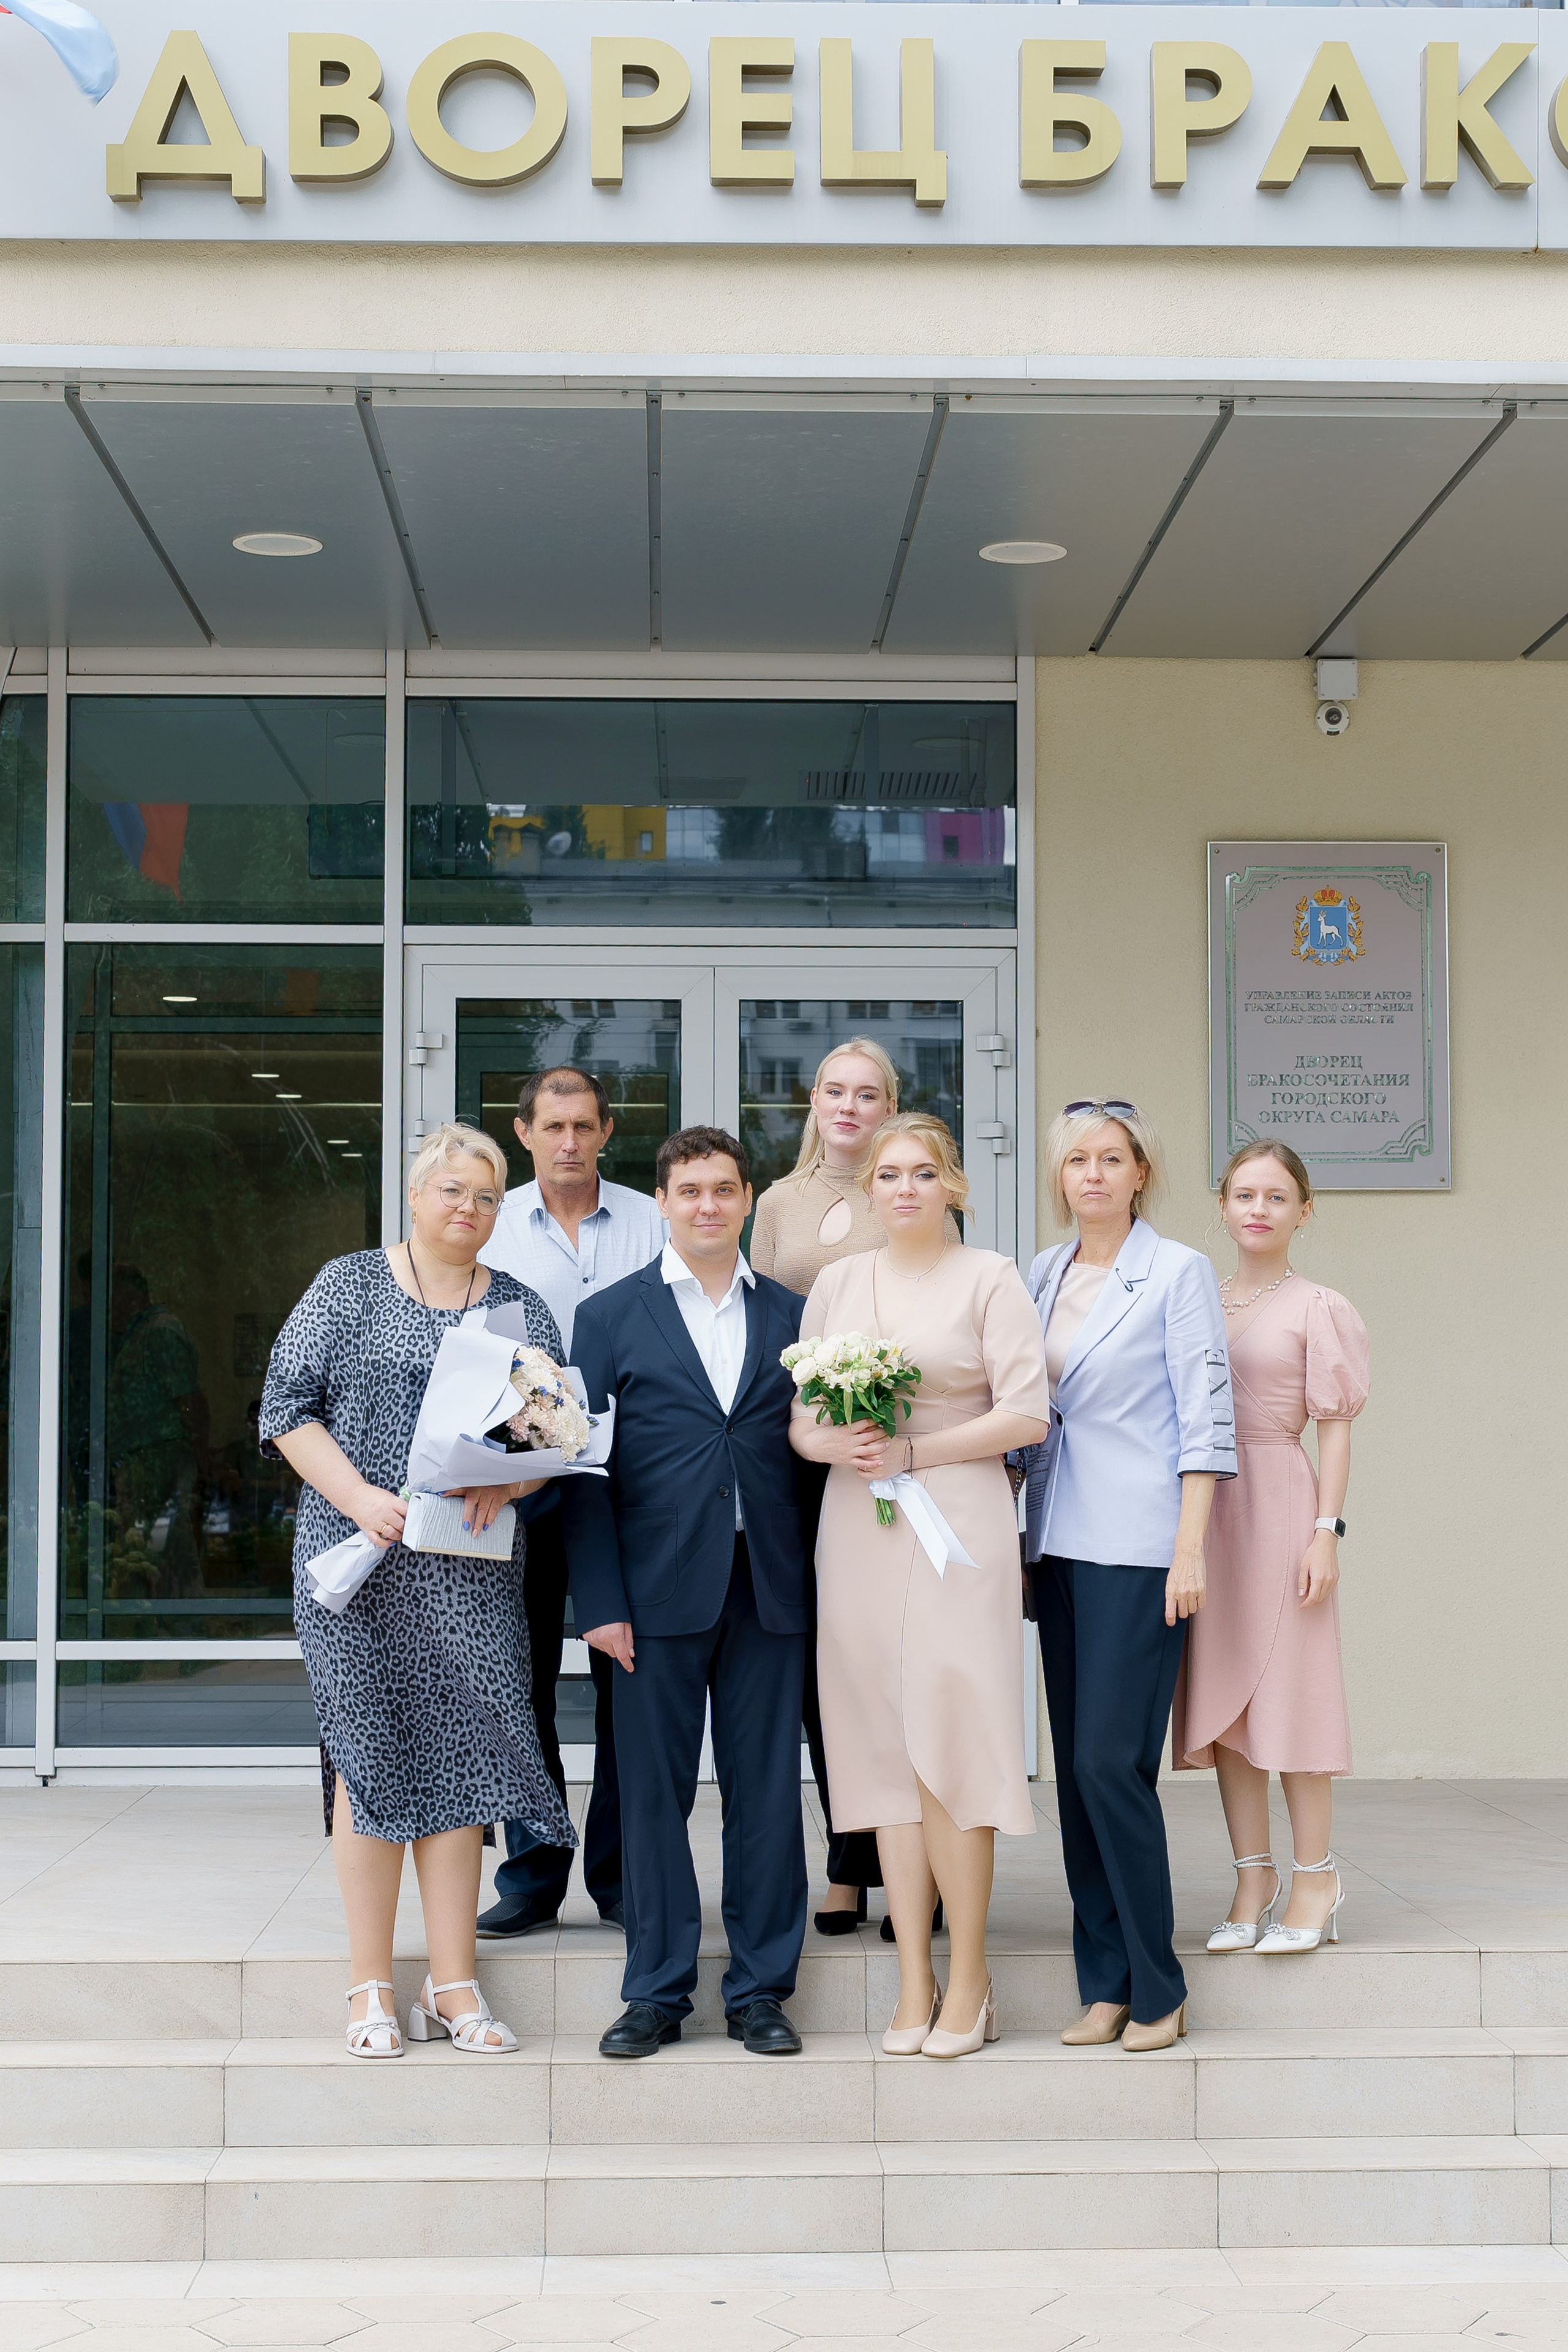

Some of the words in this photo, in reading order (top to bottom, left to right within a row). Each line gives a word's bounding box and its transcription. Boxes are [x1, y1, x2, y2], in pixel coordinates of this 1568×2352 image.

[106, 29, 947, 208] ДВОРЕЦ
[1019, 39, 1568, 190] БРАК
[1245, 990, 1322, 1000] УПРАВЛЕНИЕ
[1324, 990, 1371, 1000] ЗАПИСИ
[1374, 990, 1412, 1000] АКТОВ
[1244, 1003, 1338, 1012] ГРАЖДАНСКОГО
[1341, 1003, 1414, 1012] СОСТОЯНИЯ
[1264, 1014, 1337, 1024] САМАРСКОЙ
[1340, 1015, 1395, 1024] ОБЛАСТИ
[1294, 1055, 1363, 1071] ДВОРЕЦ
[1247, 1074, 1411, 1087] БРАКОСОЧЕТАНИЯ
[1271, 1092, 1387, 1107] ГОРОДСКОГО
[1258, 1110, 1325, 1123] ОКРУГА
[1330, 1110, 1400, 1123] САМАРА
[1205, 1349, 1236, 1455] LUXE
